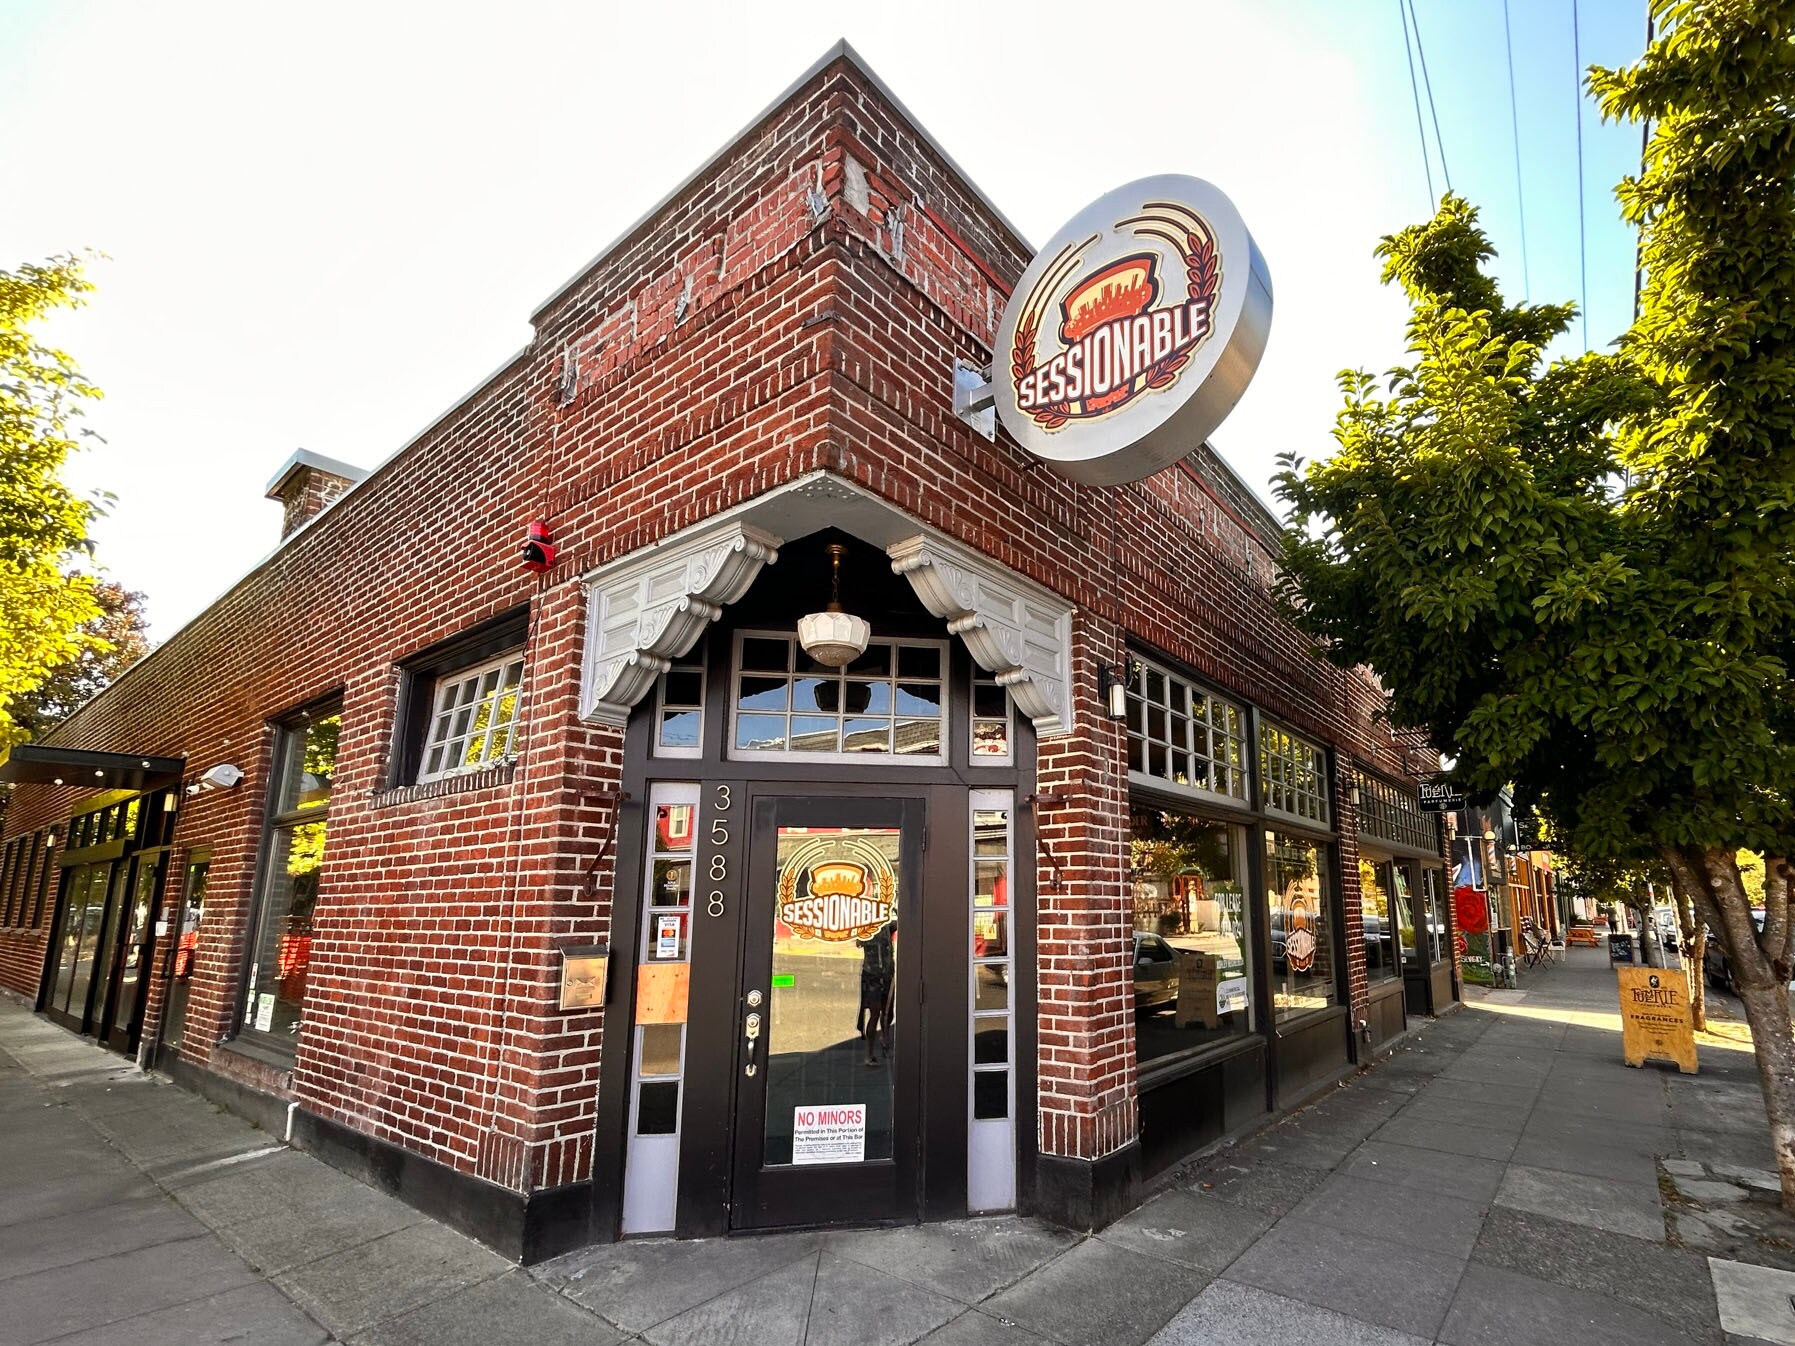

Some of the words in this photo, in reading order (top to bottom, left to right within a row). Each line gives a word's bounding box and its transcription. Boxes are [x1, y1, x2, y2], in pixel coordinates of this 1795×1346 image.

[1018, 301, 1208, 408] SESSIONABLE
[783, 895, 890, 931] SESSIONABLE
[1630, 1014, 1684, 1024] FRAGRANCES
[798, 1111, 815, 1126] NO
[818, 1110, 862, 1126] MINORS
